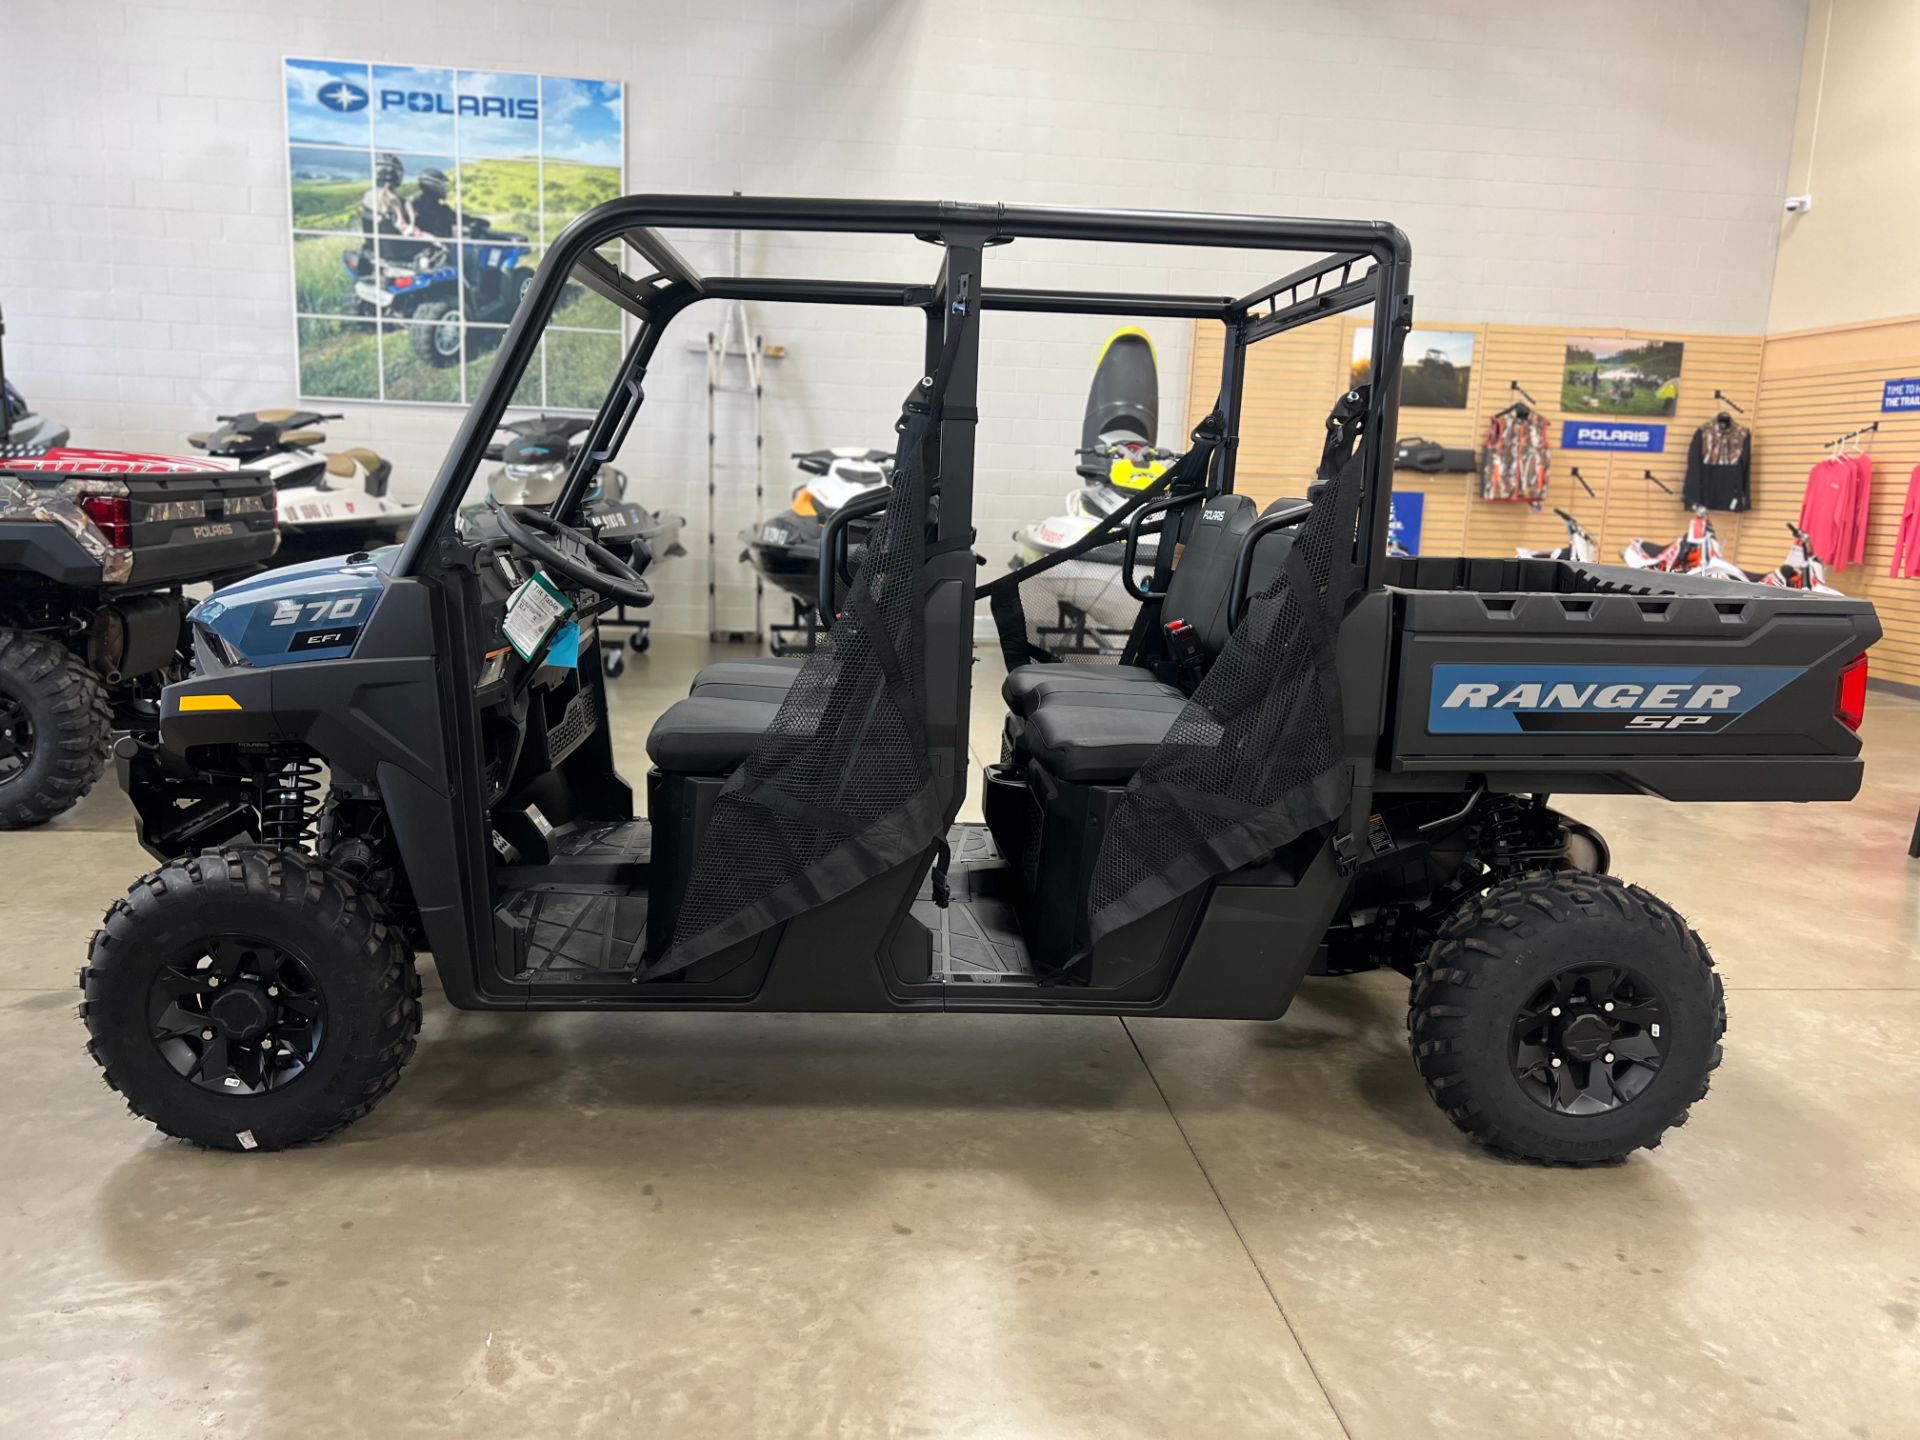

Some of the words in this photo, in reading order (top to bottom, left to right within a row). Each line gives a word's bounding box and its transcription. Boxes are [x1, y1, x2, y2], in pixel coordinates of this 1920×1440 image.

[380, 89, 539, 120] POLARIS
[1887, 384, 1904, 395] TIME
[1905, 383, 1915, 394] TO
[1885, 397, 1899, 407] THE
[1577, 428, 1650, 442] POLARIS
[1202, 510, 1226, 522] POLARIS
[193, 523, 233, 539] POLARIS
[270, 598, 362, 626] 570
[307, 633, 342, 644] EFI
[1441, 683, 1742, 709] RANGER
[1624, 715, 1713, 729] SP
